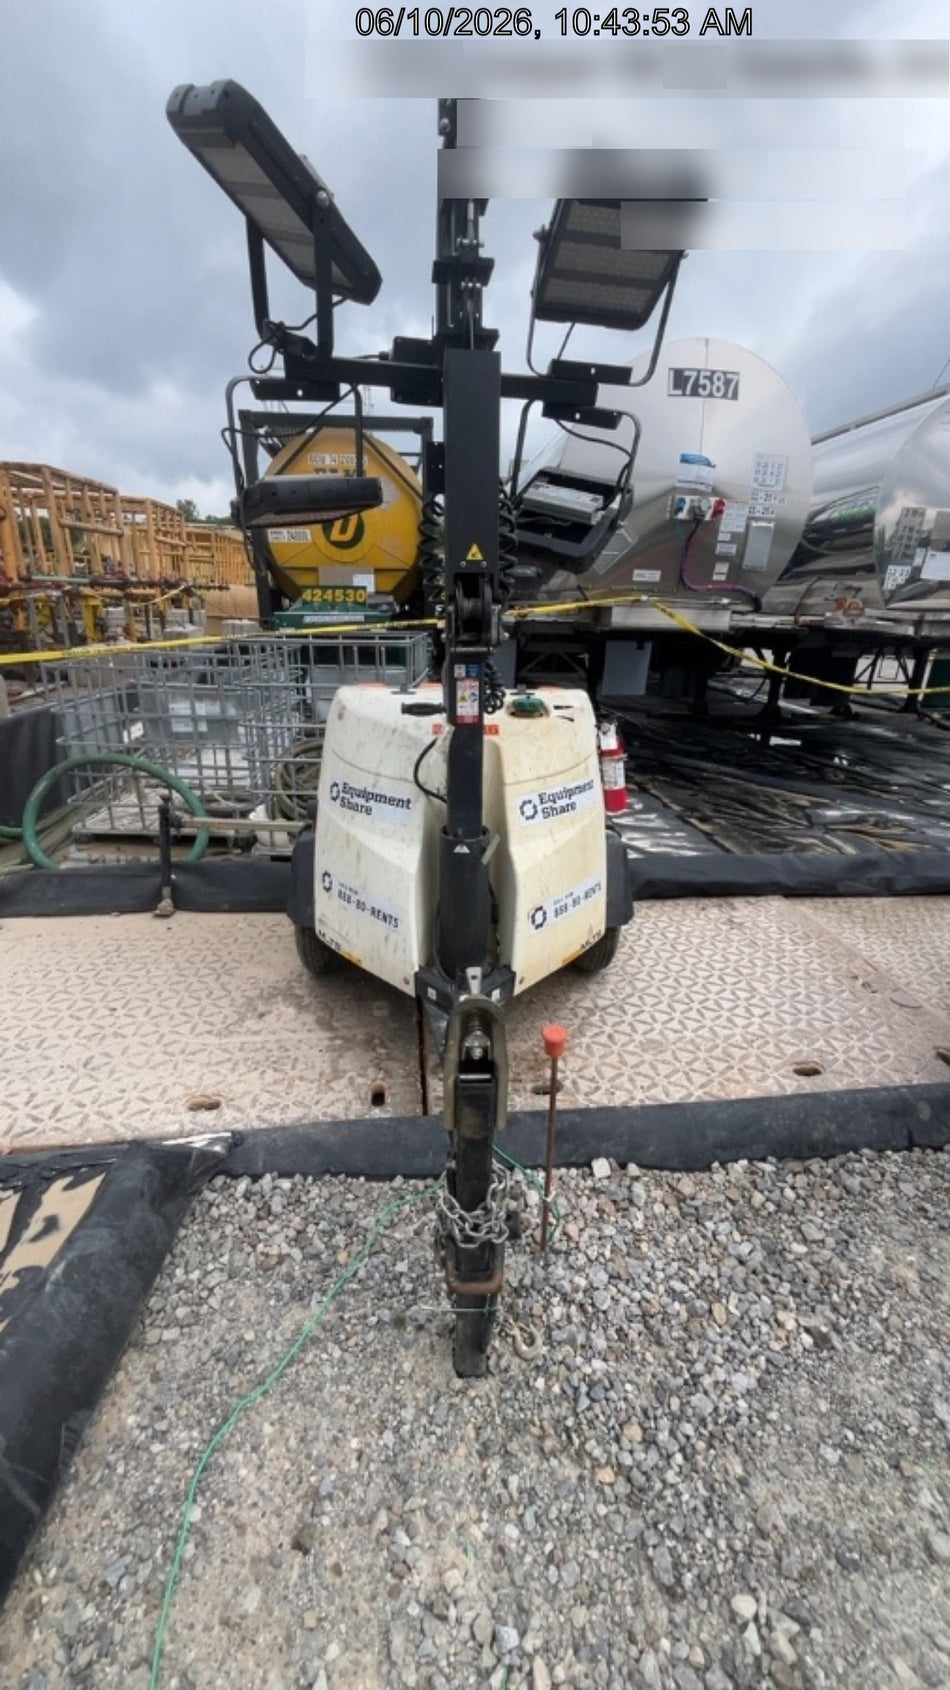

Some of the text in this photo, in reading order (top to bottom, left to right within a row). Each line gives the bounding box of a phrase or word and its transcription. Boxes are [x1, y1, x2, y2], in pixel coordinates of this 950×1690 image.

[668, 370, 740, 400] L7587
[301, 588, 366, 602] 424530
[341, 781, 412, 810] Equipment
[538, 779, 594, 805] Equipment
[340, 795, 373, 815] Share
[541, 801, 577, 819] Share
